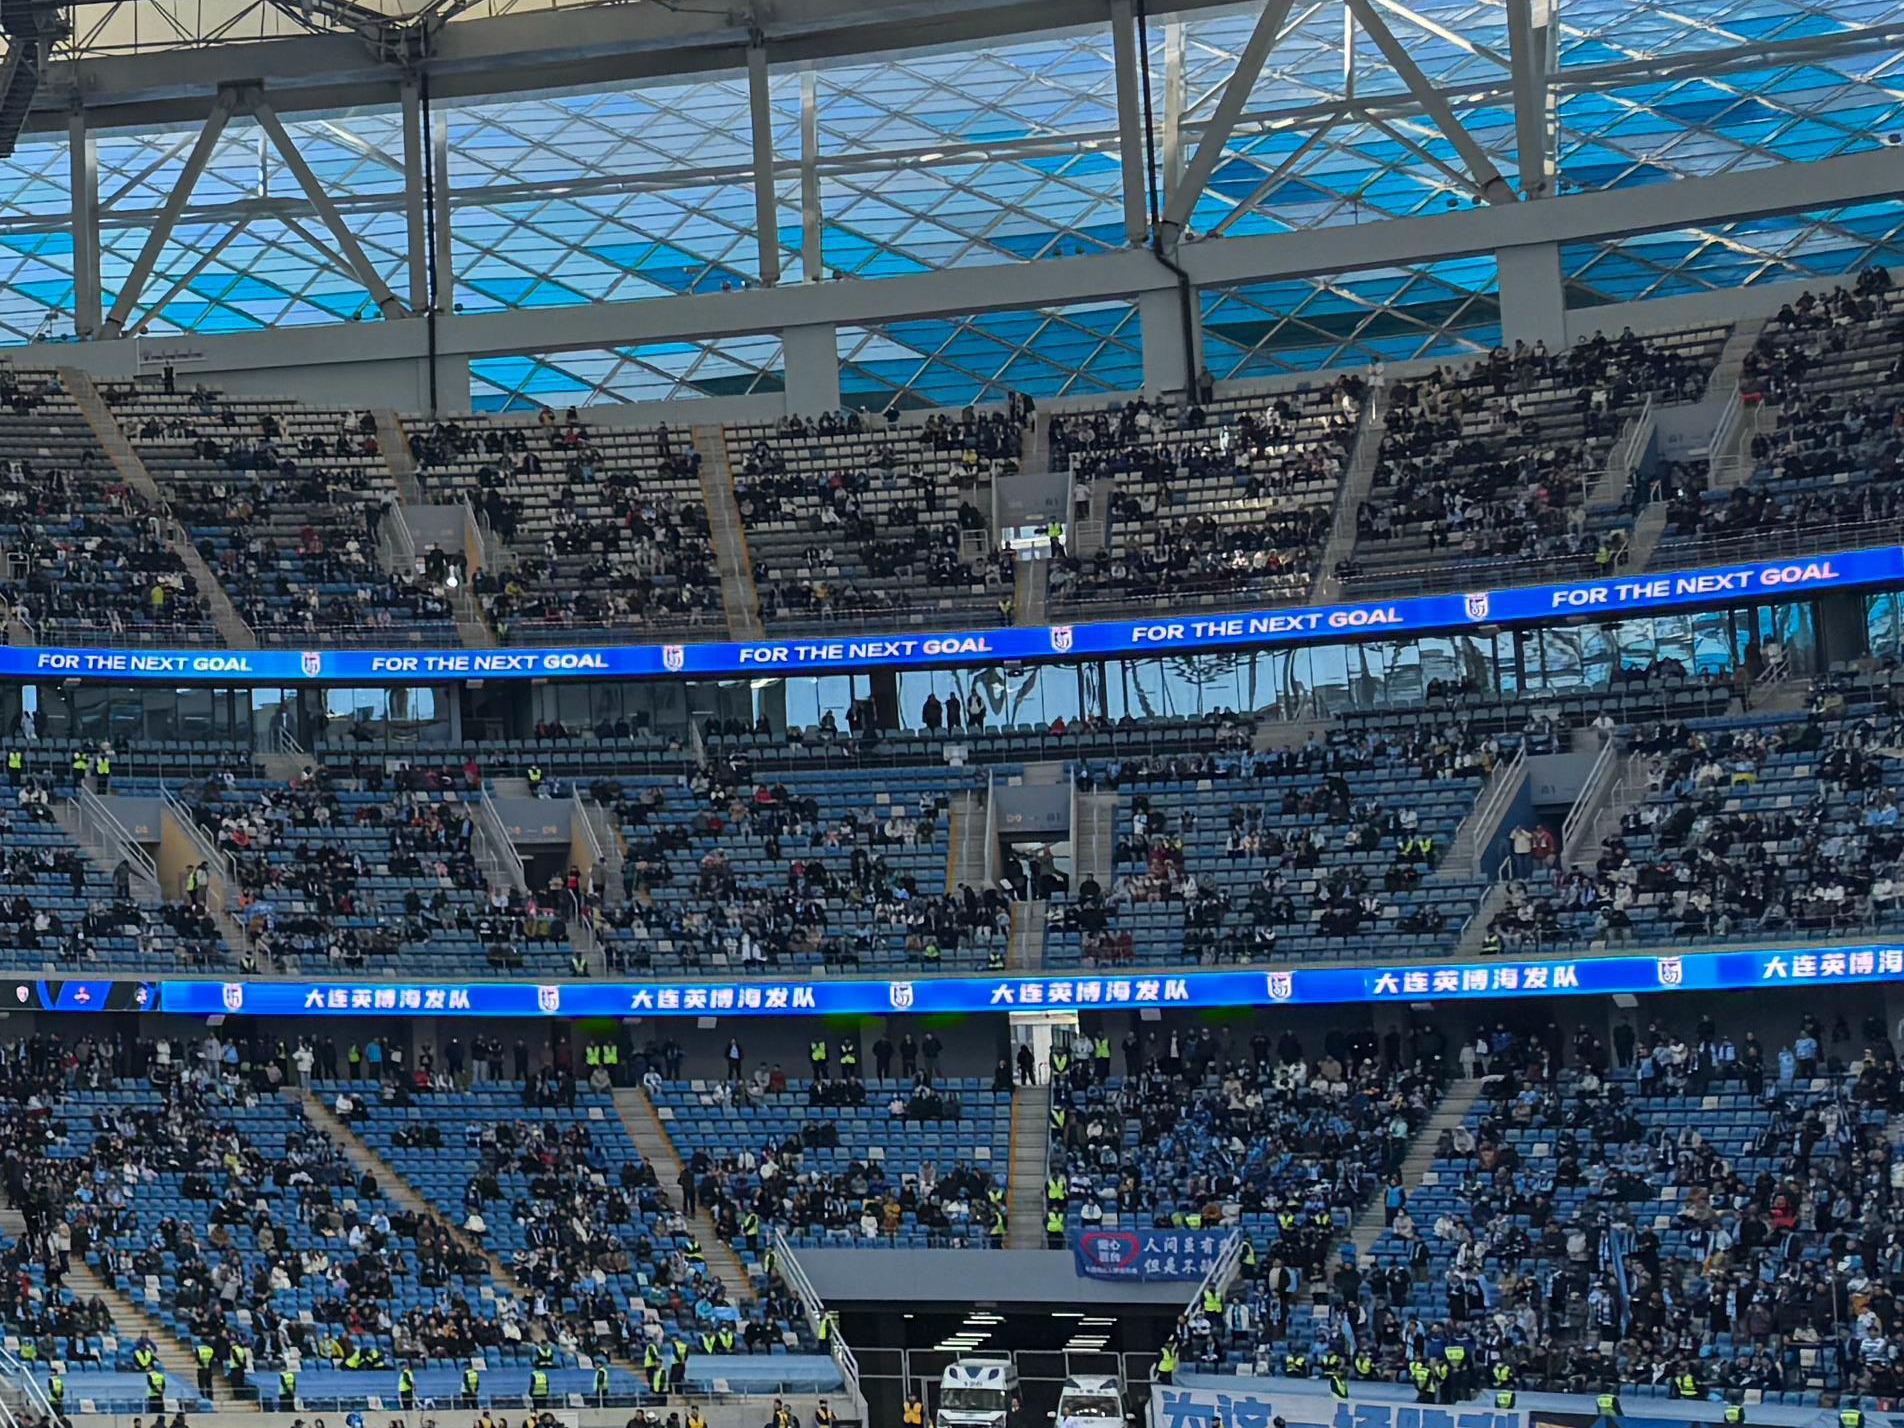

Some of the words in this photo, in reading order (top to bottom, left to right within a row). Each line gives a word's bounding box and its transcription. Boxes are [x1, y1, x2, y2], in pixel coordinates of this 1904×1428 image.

[1553, 588, 1607, 606] FOR
[1616, 581, 1669, 600] THE
[1677, 572, 1753, 594] NEXT
[1761, 563, 1839, 585] GOAL
[1133, 625, 1184, 641] FOR
[1192, 621, 1242, 637] THE
[1250, 614, 1322, 633] NEXT
[1329, 608, 1403, 627] GOAL
[740, 648, 788, 662] FOR
[795, 645, 843, 660] THE
[850, 642, 917, 658] NEXT
[923, 637, 992, 654] GOAL
[38, 655, 79, 668] FOR
[86, 656, 125, 669] THE
[131, 657, 186, 670] NEXT
[194, 658, 251, 671] GOAL
[373, 658, 418, 671] FOR
[425, 658, 468, 670] THE
[475, 656, 538, 669] NEXT
[544, 655, 608, 668] GOAL
[1764, 951, 1903, 978] 大连英博海
[991, 980, 1189, 1004] 大连英博海发队
[1374, 966, 1579, 994] 大连英博海发队
[305, 989, 470, 1008] 大连英博海发队
[631, 988, 815, 1009] 大连英博海发队
